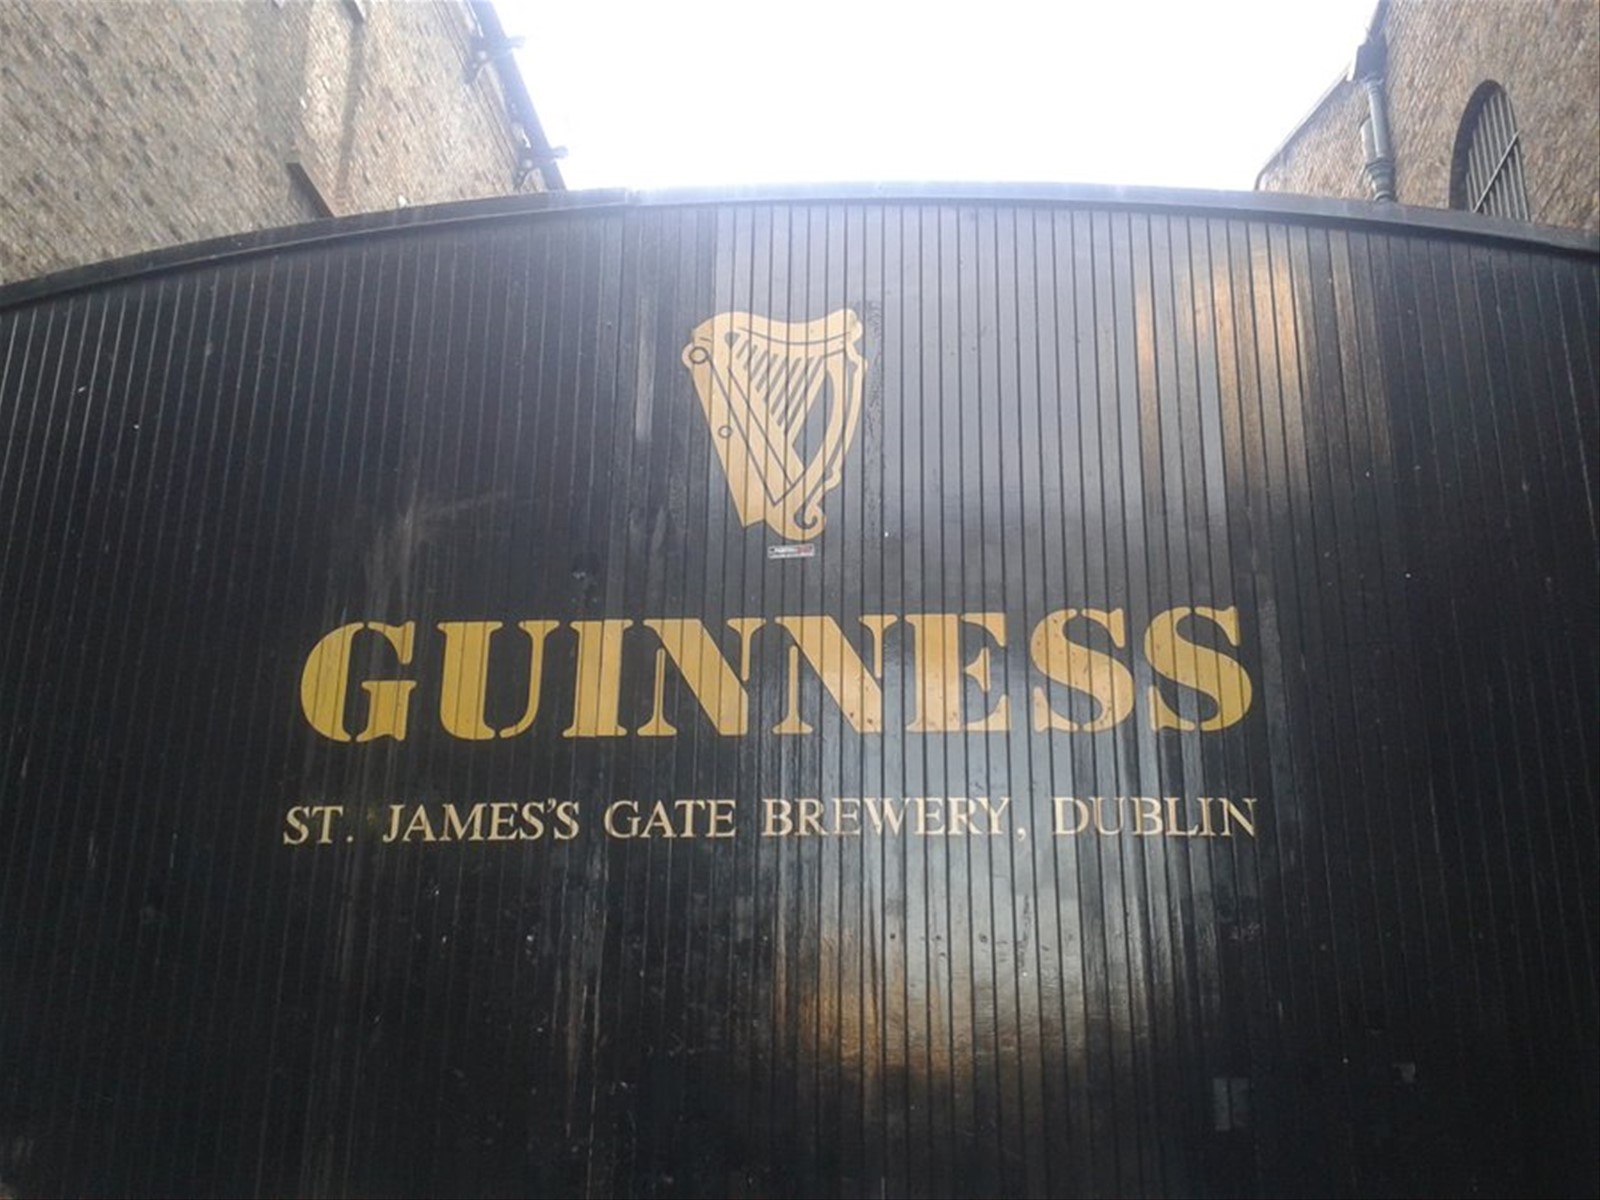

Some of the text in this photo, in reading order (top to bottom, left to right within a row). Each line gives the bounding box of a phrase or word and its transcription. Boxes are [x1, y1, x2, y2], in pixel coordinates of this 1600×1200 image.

[300, 606, 1253, 743] GUINNESS
[283, 796, 1258, 845] ST. JAMES'S GATE BREWERY, DUBLIN
